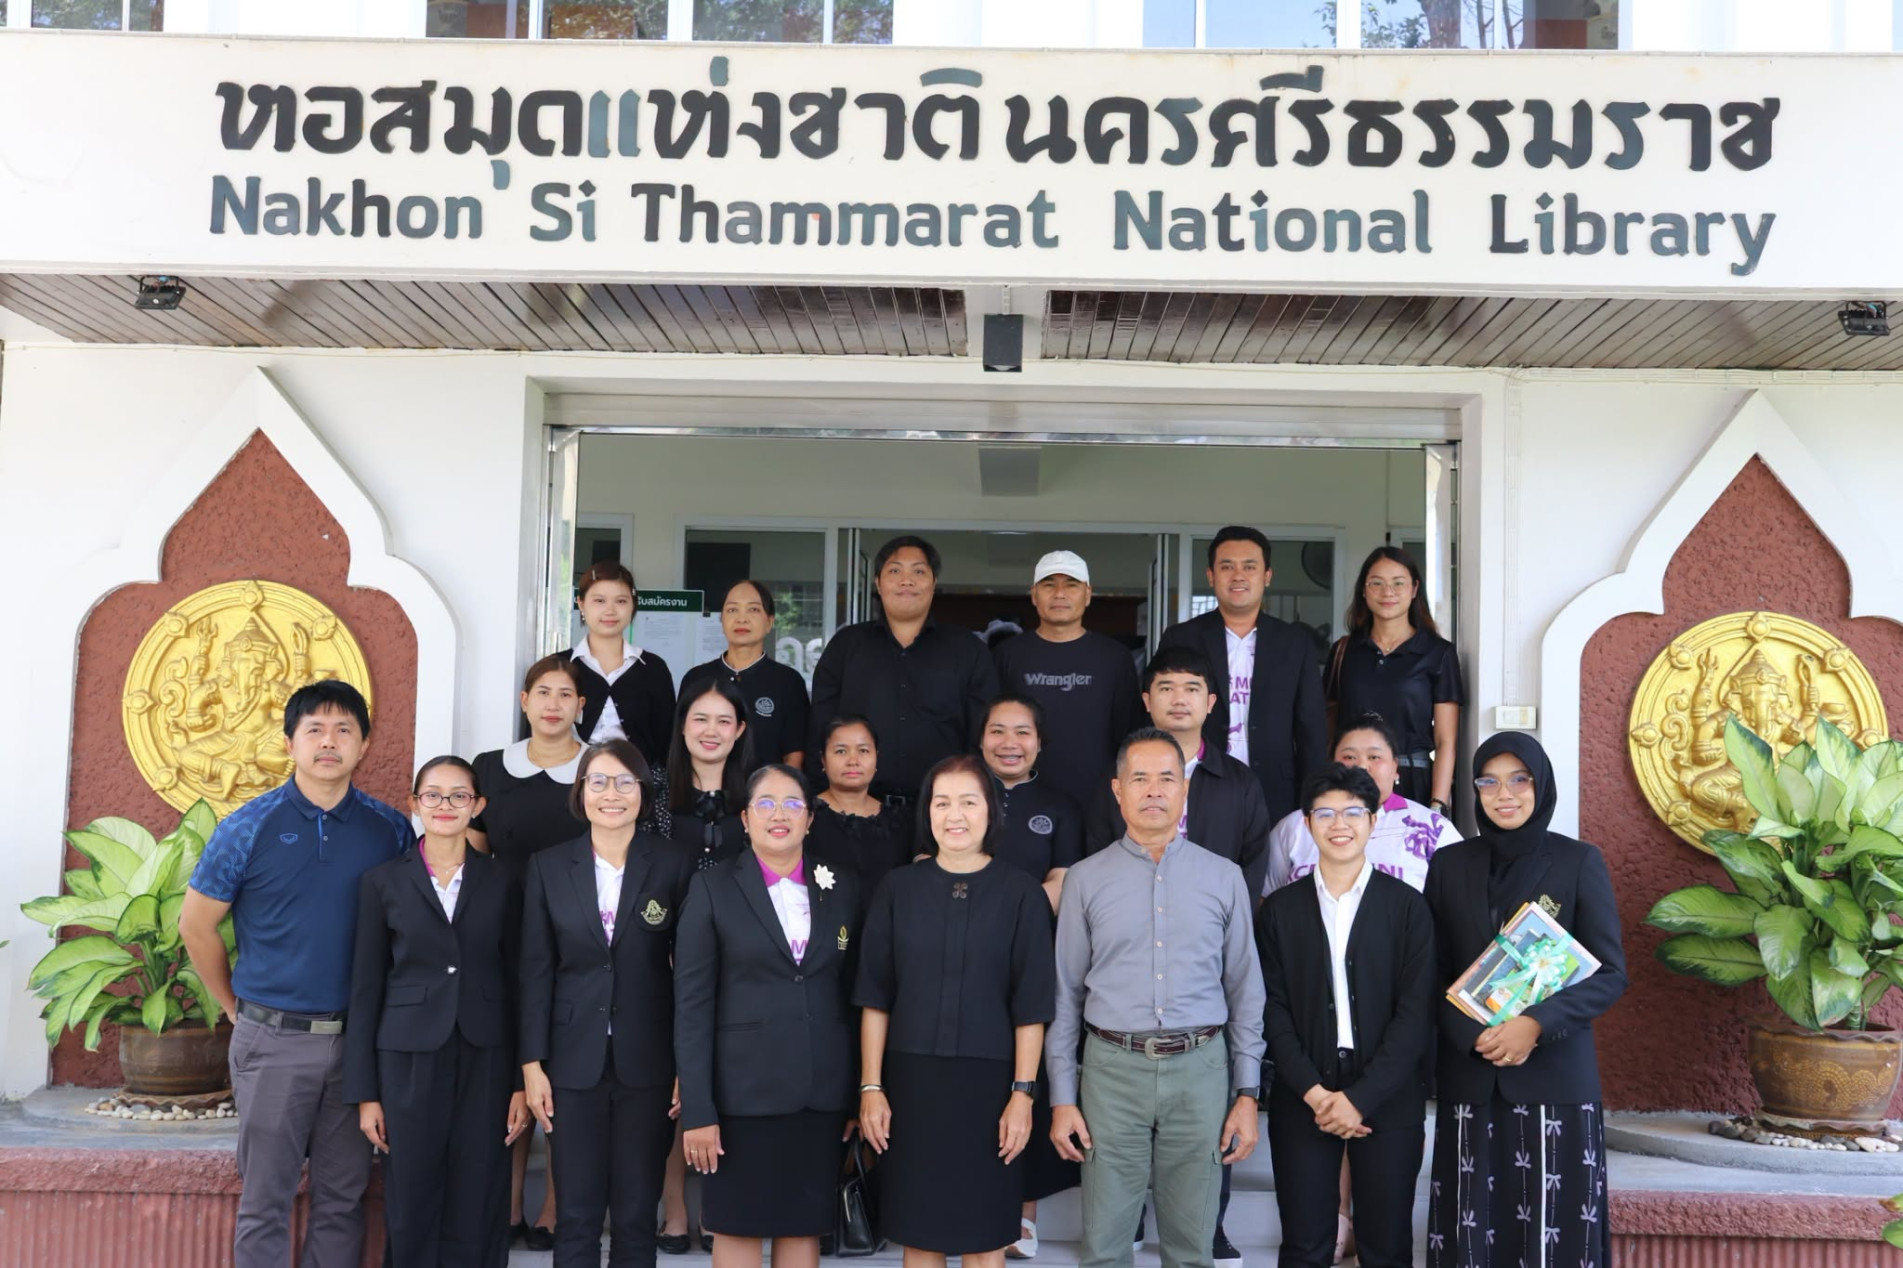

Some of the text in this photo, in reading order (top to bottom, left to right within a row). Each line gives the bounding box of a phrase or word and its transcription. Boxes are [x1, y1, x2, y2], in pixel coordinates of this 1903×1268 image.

[215, 56, 1781, 190] หอสมุดแห่งชาติ นครศรีธรรมราช
[210, 175, 1776, 276] Nakhon Si Thammarat National Library
[1024, 672, 1092, 692] Wrangler
